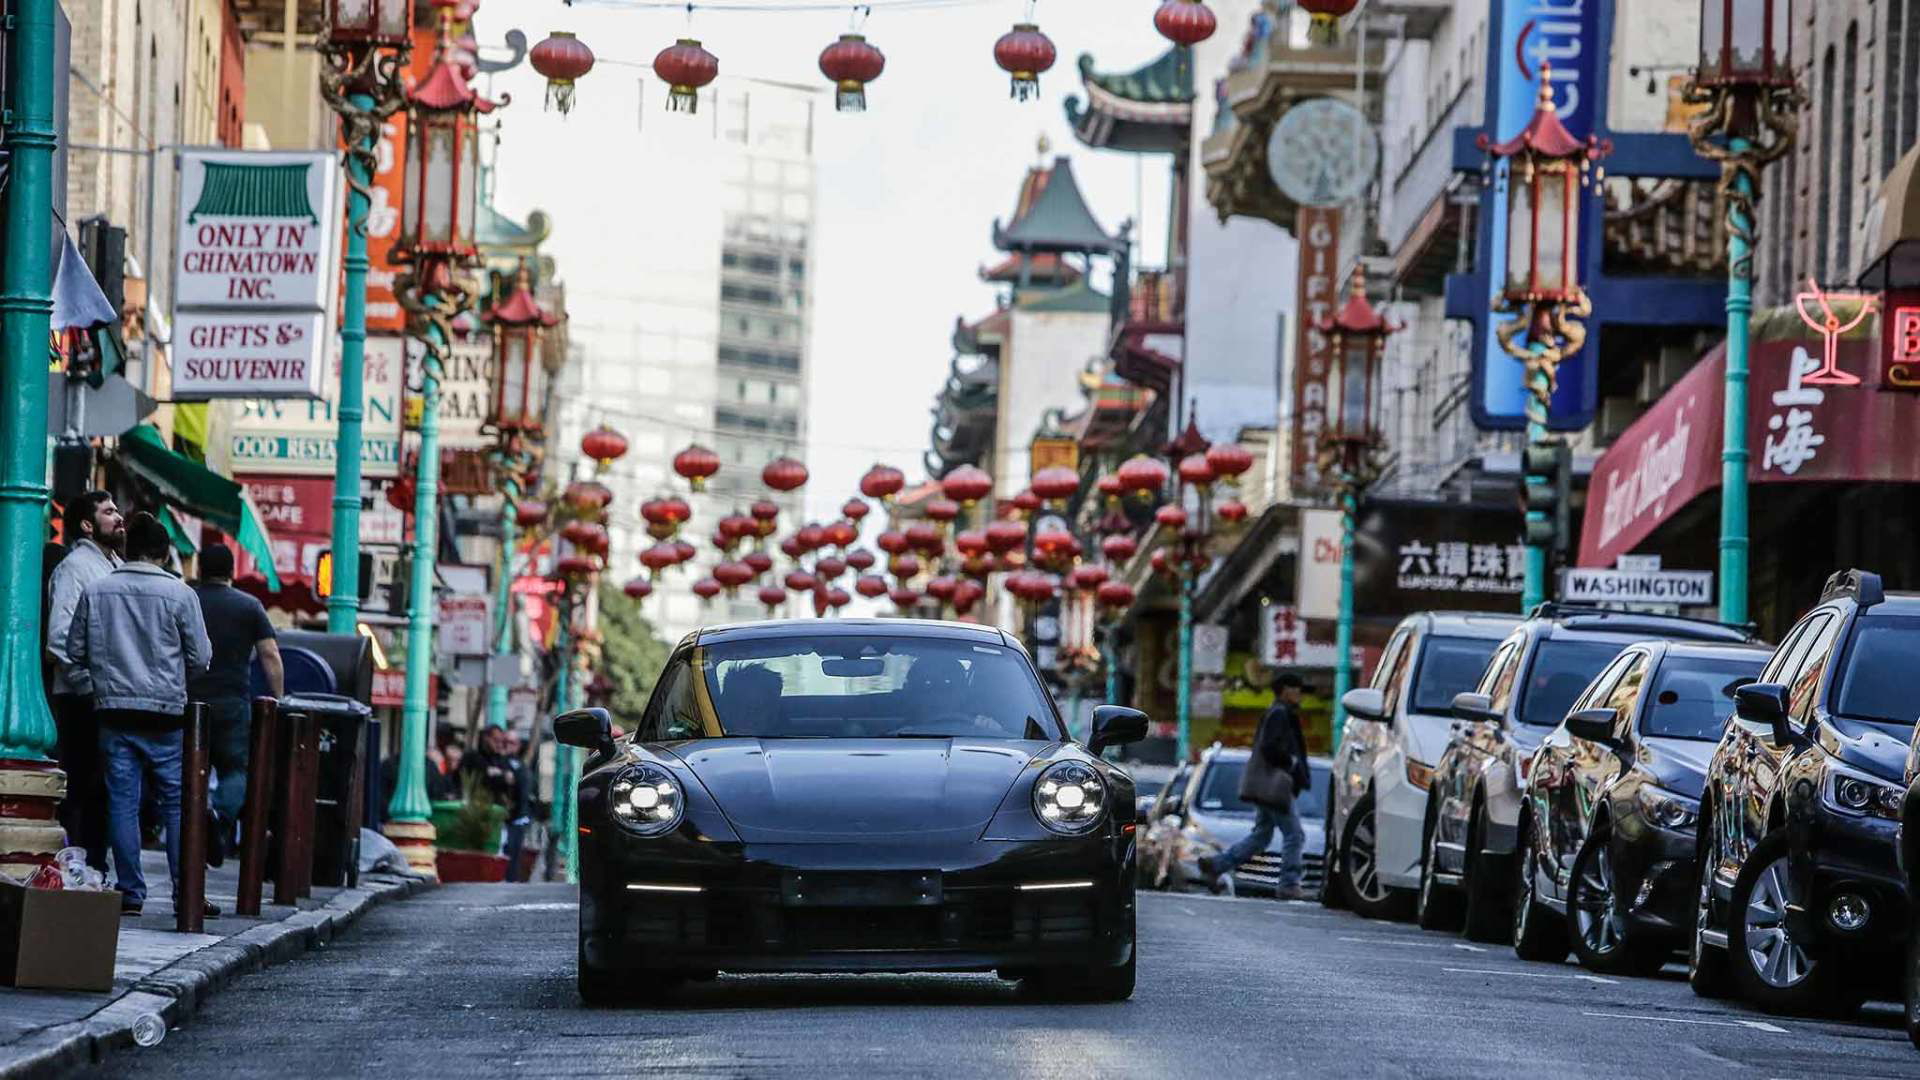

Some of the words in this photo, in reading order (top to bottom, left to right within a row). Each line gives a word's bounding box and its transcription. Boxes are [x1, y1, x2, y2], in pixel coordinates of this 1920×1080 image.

[198, 224, 269, 248] ONLY
[276, 224, 306, 248] IN
[184, 252, 317, 274] CHINATOWN
[228, 278, 275, 299] INC.
[1306, 221, 1332, 352] GIFTS
[190, 324, 269, 348] GIFTS
[276, 323, 303, 345] &
[185, 358, 305, 381] SOUVENIR
[1763, 346, 1825, 475] 上海
[288, 438, 394, 461] RESTAANT
[259, 503, 302, 524] CAFE
[1573, 576, 1704, 597] WASHINGTON
